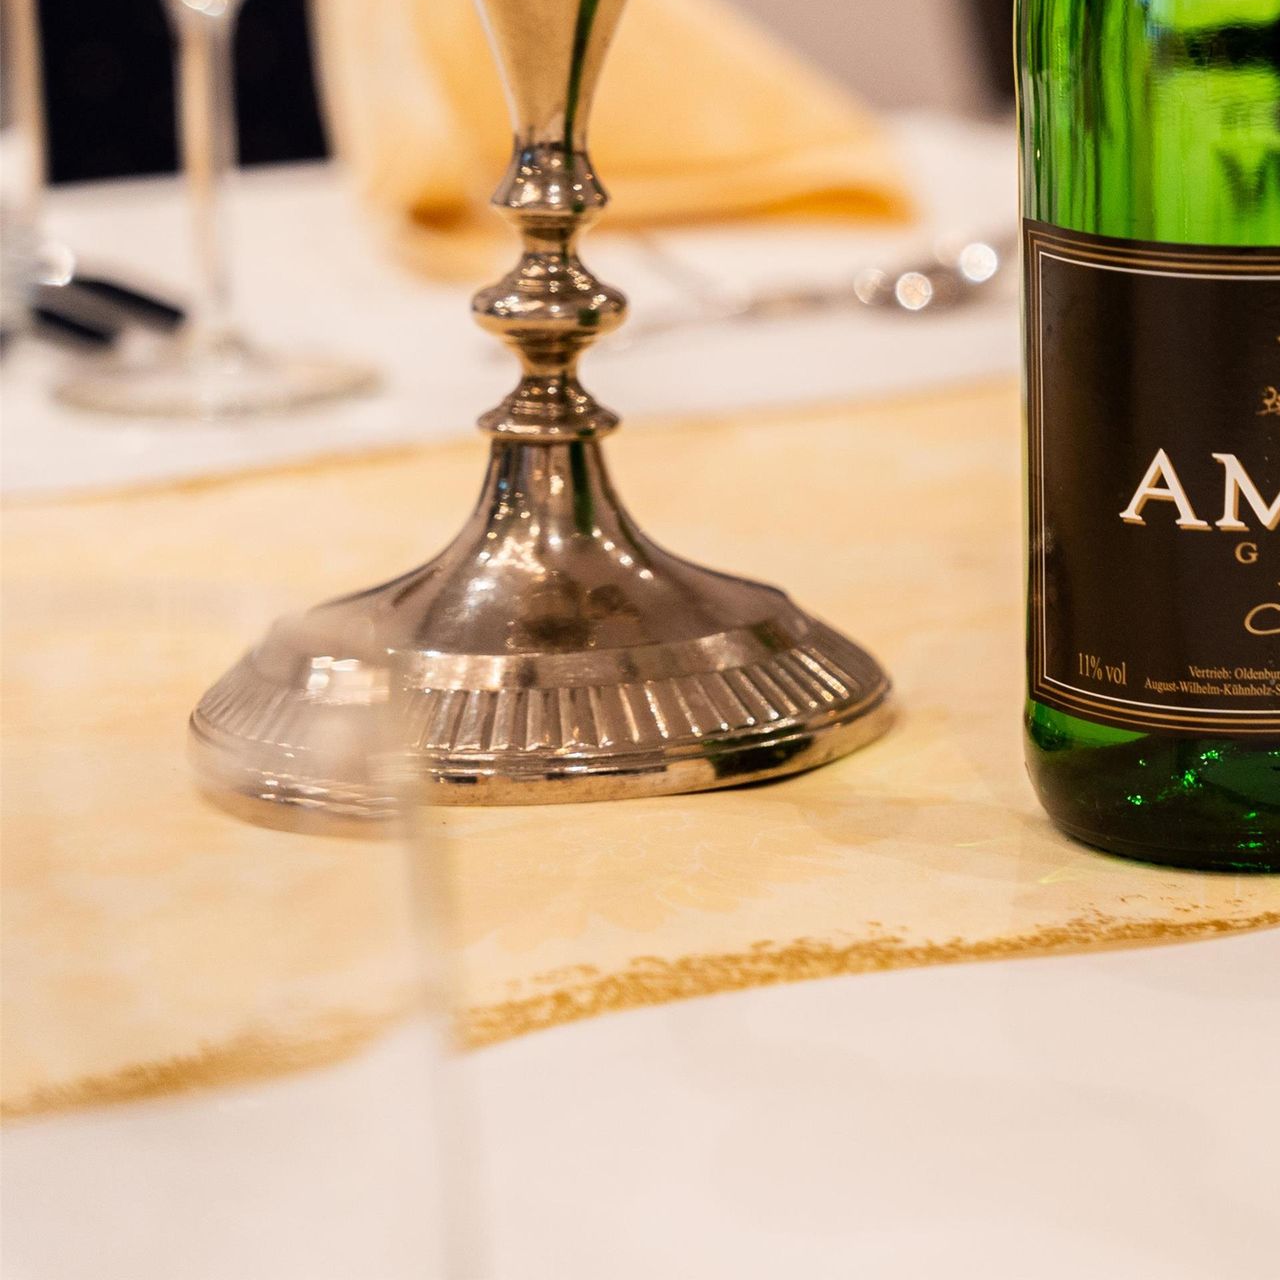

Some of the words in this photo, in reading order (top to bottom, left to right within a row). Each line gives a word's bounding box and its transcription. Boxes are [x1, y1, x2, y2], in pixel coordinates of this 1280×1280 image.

[1077, 651, 1103, 682] 11%
[1104, 660, 1128, 686] vol
[1188, 665, 1233, 679] Vertrieb:
